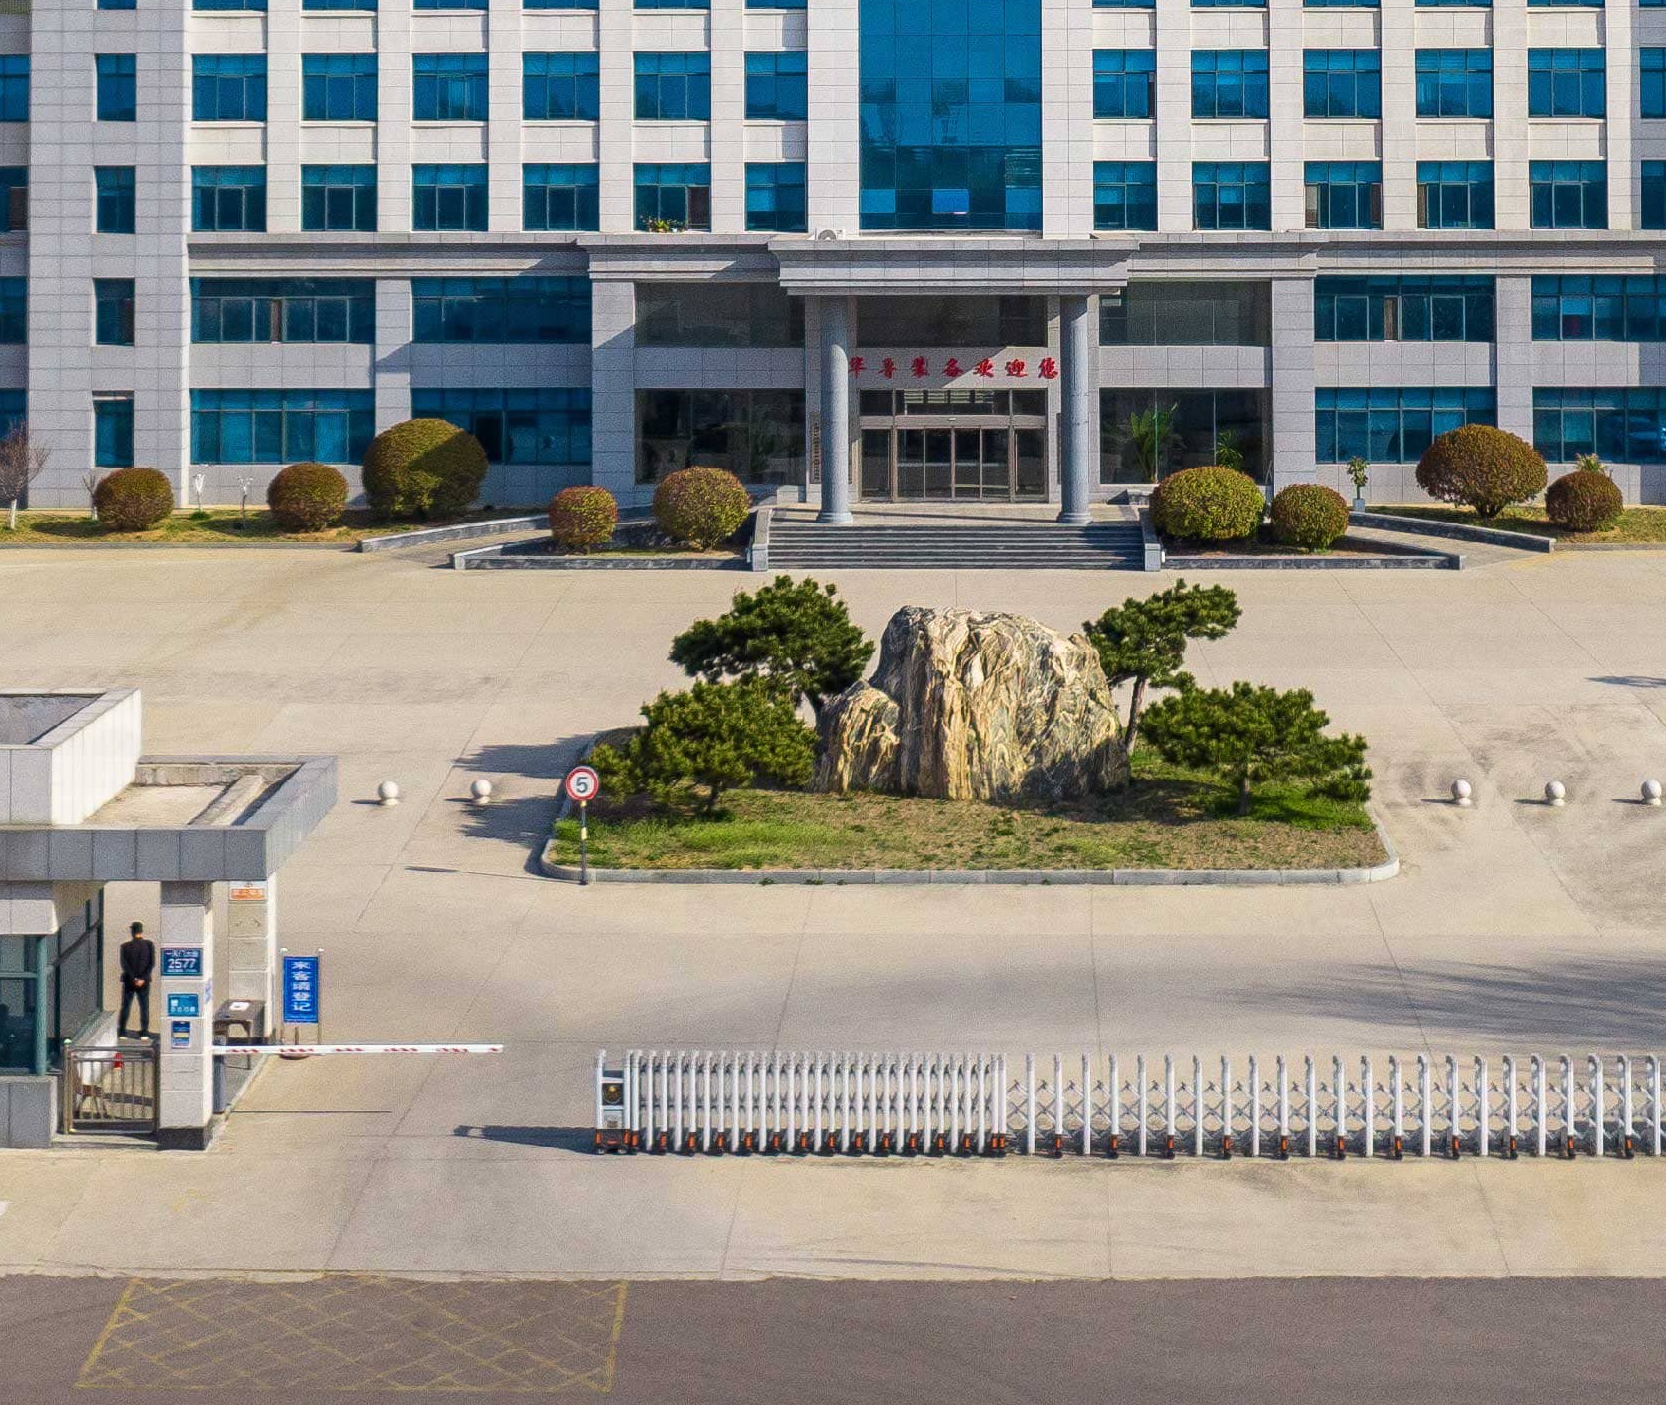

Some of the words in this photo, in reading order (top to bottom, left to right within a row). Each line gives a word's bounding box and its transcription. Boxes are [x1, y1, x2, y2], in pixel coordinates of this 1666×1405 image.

[576, 777, 588, 793] 5
[168, 958, 196, 969] 2577
[291, 961, 312, 1012] 来客请登记
